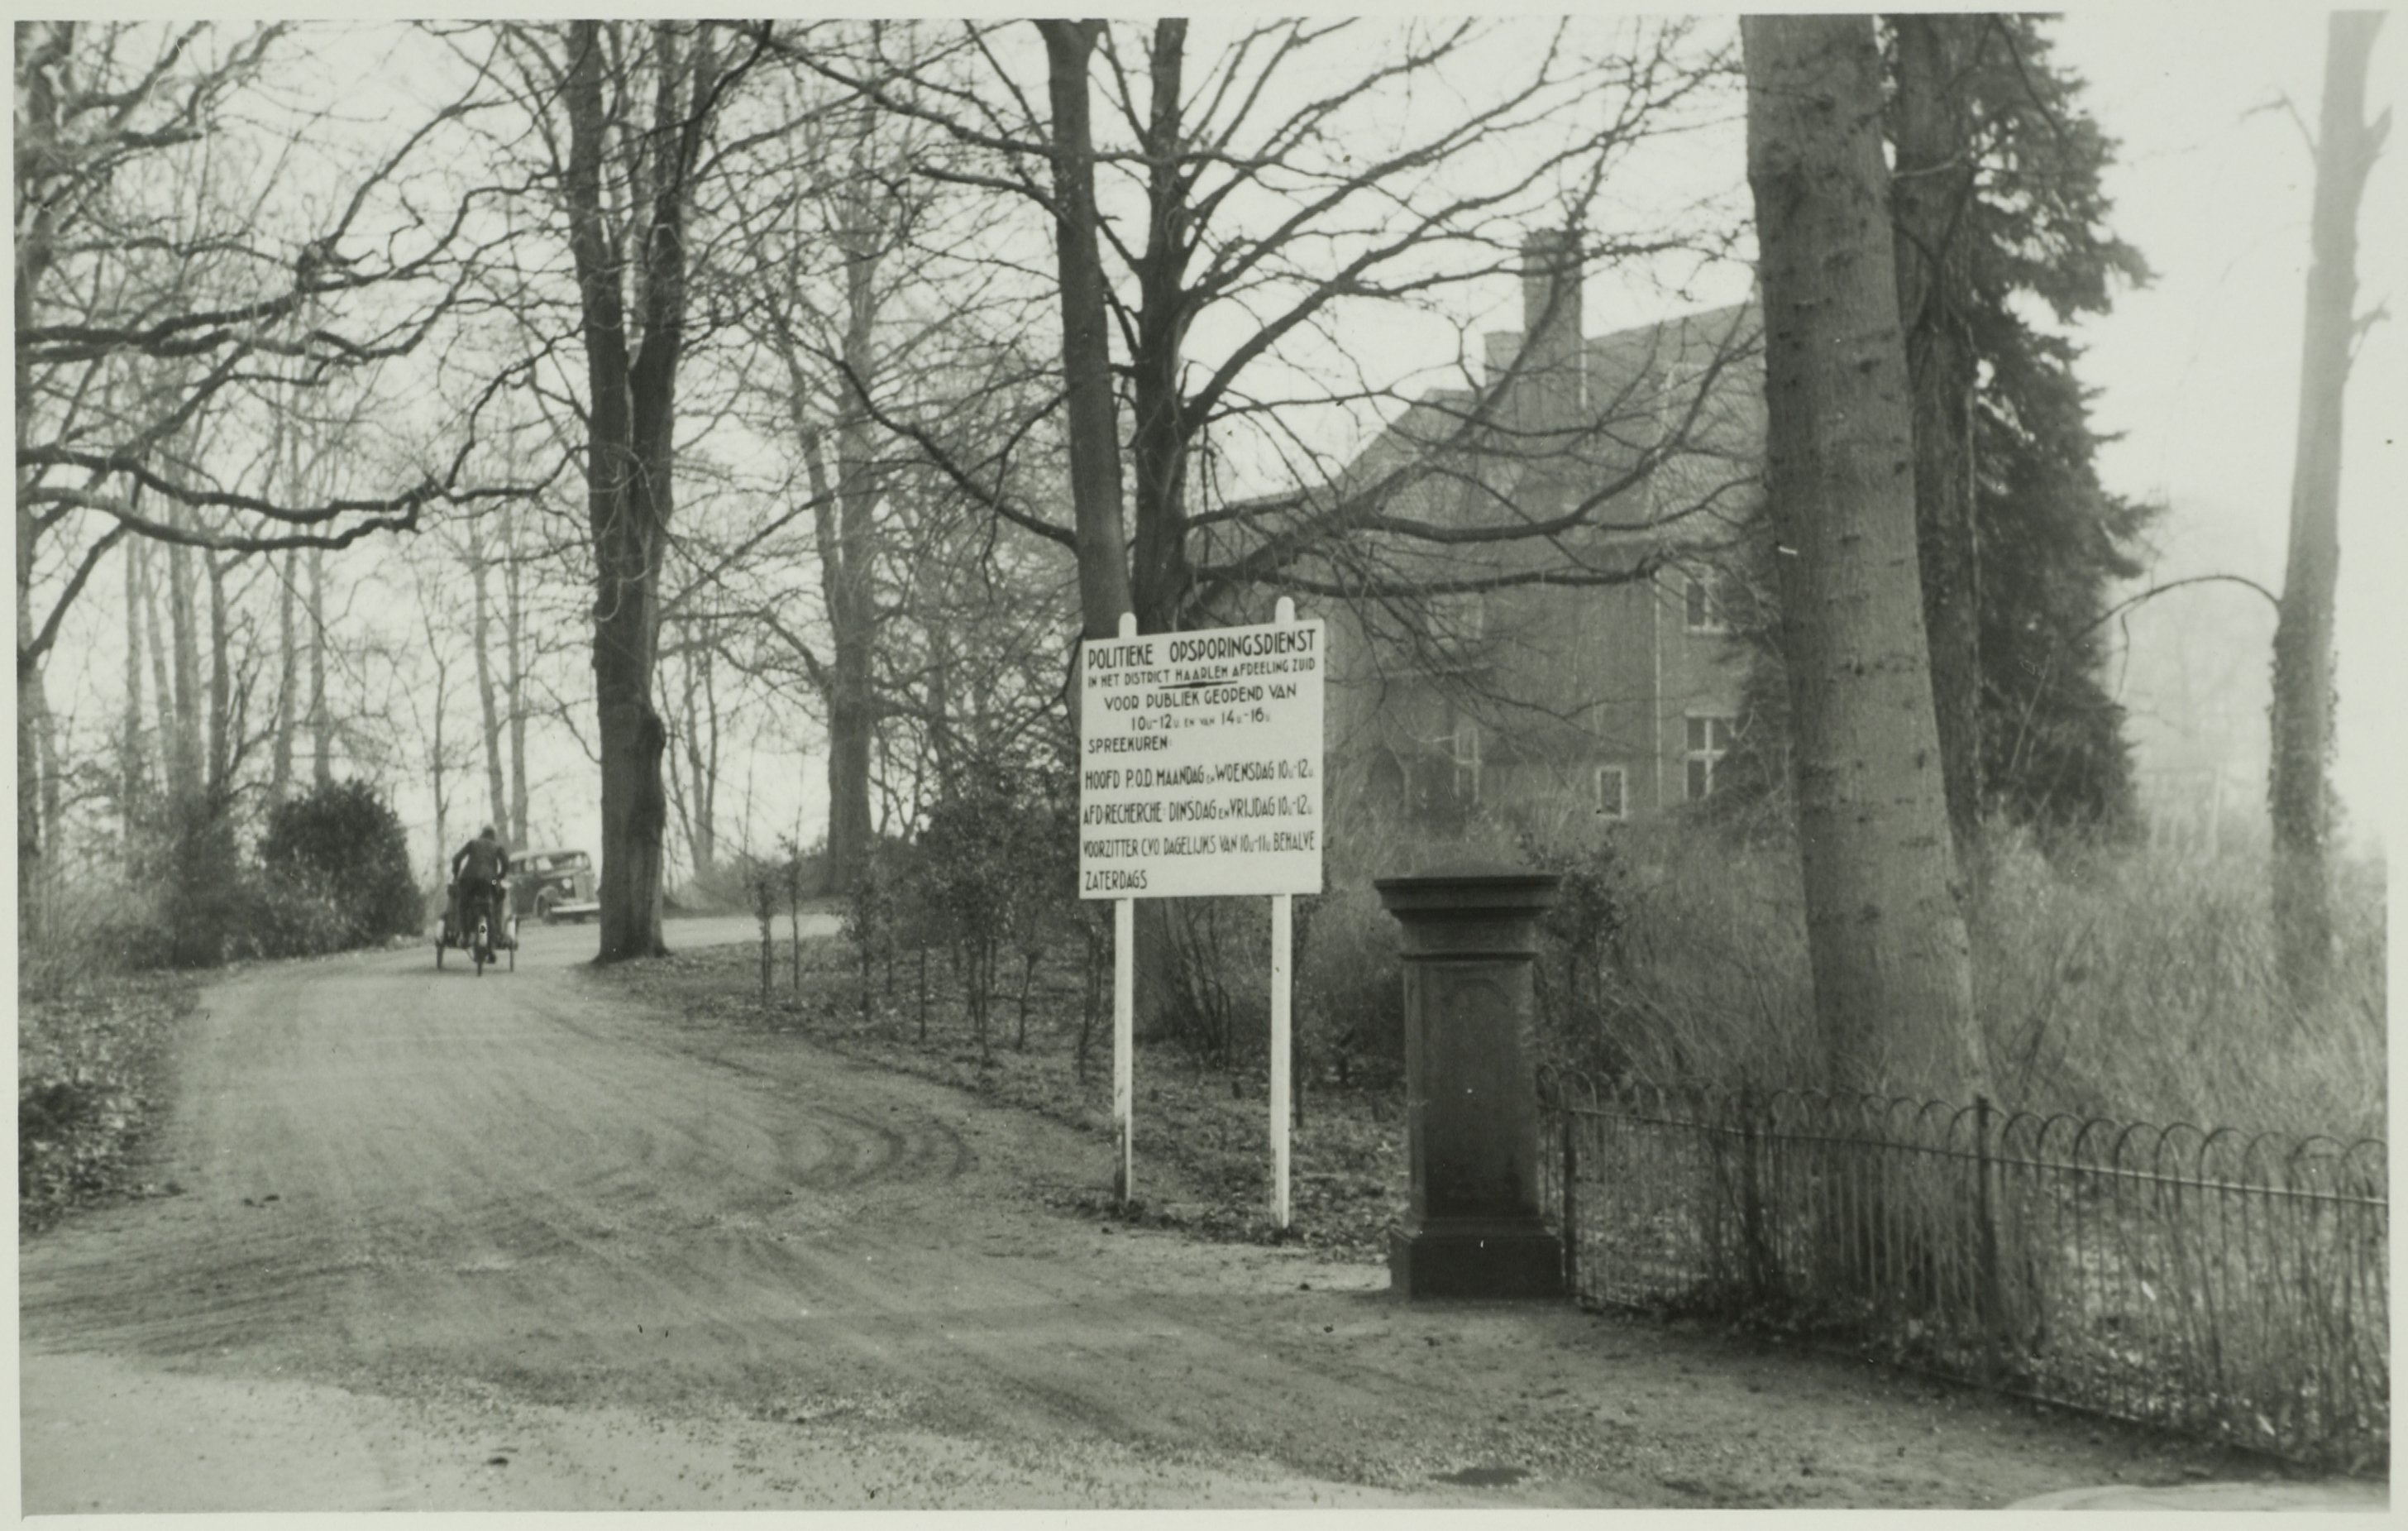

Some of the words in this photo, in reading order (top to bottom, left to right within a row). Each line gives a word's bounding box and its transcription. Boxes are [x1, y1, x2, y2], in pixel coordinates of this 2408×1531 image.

[1088, 643, 1154, 670] POLITIEKE
[1169, 629, 1316, 663] OPSPORINGSDIENST
[1088, 676, 1097, 689] IN
[1101, 673, 1120, 687] HET
[1125, 669, 1170, 687] DISTRICT
[1176, 665, 1228, 682] HAARLEM
[1232, 660, 1289, 678] AFDEELING
[1292, 657, 1316, 672] ZUID
[1104, 696, 1140, 711] VOOR
[1147, 690, 1200, 709] PUBLIEK
[1204, 686, 1264, 706] GEOPEND
[1268, 683, 1297, 700] VAN
[1086, 770, 1120, 790] HOOFD
[1157, 765, 1205, 787] MAANDAG
[1215, 760, 1274, 782] WOENSDAG
[1169, 799, 1216, 822] DINSDAG
[1230, 796, 1275, 818] VRIJDAG
[1083, 839, 1138, 858] VOORZITTER
[1163, 835, 1216, 855] DAGELIJKS
[1219, 834, 1237, 853] VAN
[1273, 830, 1315, 851] BEHALVE
[1085, 869, 1148, 891] ZATERDAGS
